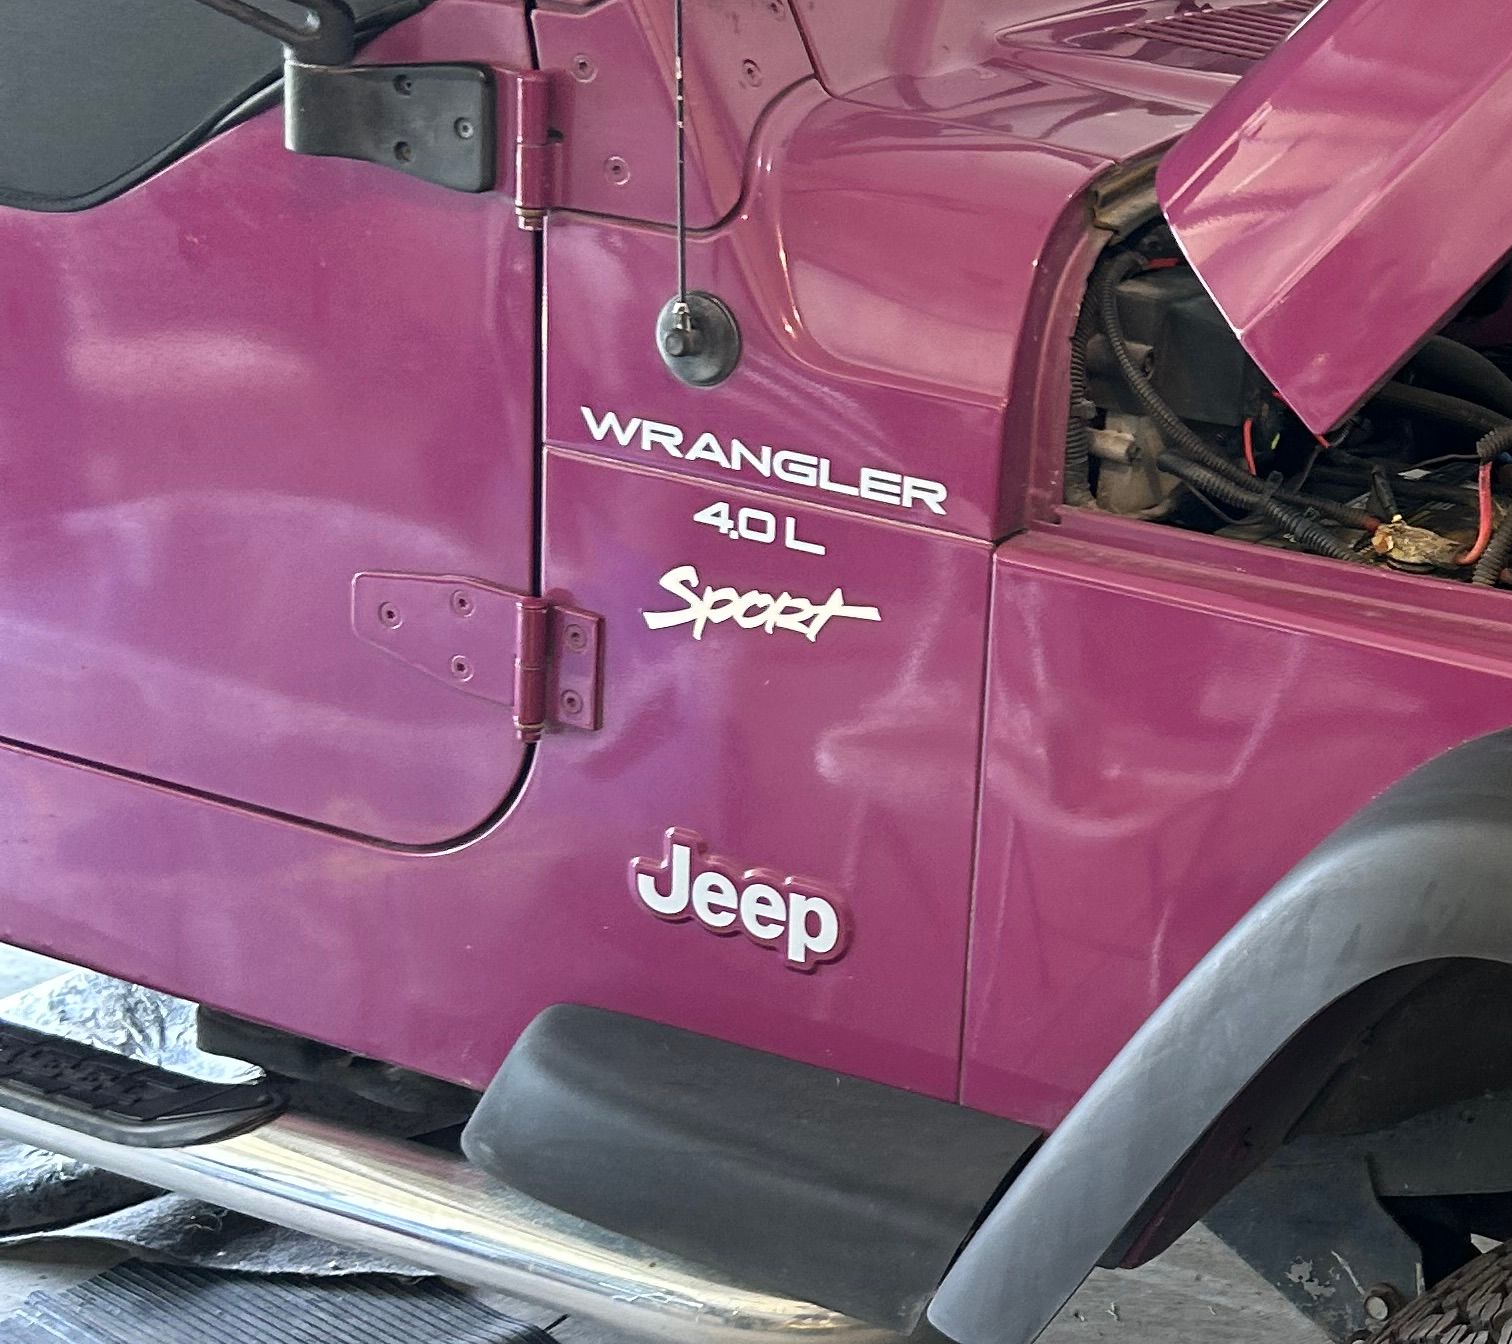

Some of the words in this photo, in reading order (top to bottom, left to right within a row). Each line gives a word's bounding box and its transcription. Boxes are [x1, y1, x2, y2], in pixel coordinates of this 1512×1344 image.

[580, 404, 948, 516] WRANGLER
[641, 564, 882, 643] Sport
[635, 835, 843, 965] Jeep
